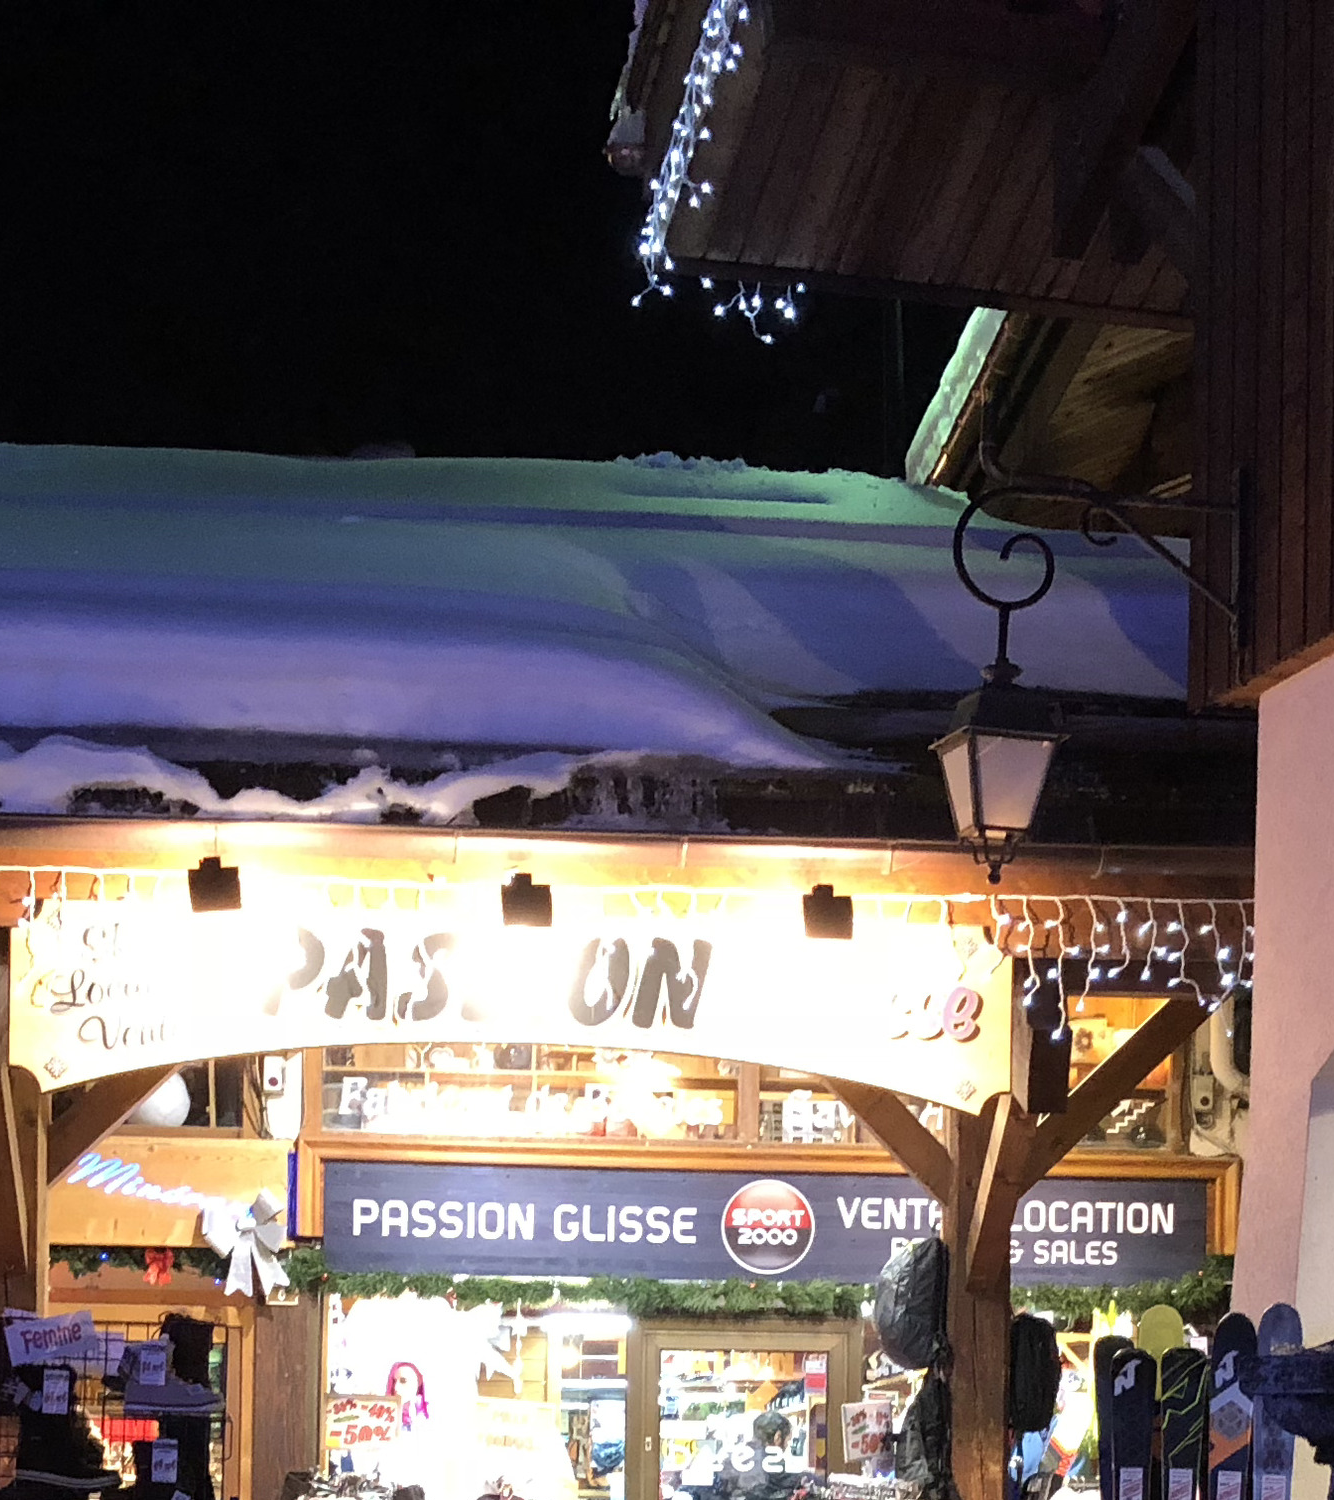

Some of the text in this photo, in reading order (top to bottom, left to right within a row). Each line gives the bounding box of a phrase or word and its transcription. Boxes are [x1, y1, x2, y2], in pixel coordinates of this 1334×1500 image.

[264, 927, 713, 1029] PASON
[352, 1198, 698, 1244] PASSION GLISSE
[730, 1208, 806, 1227] SPORT
[737, 1227, 799, 1246] 2000
[1033, 1239, 1118, 1266] SALES
